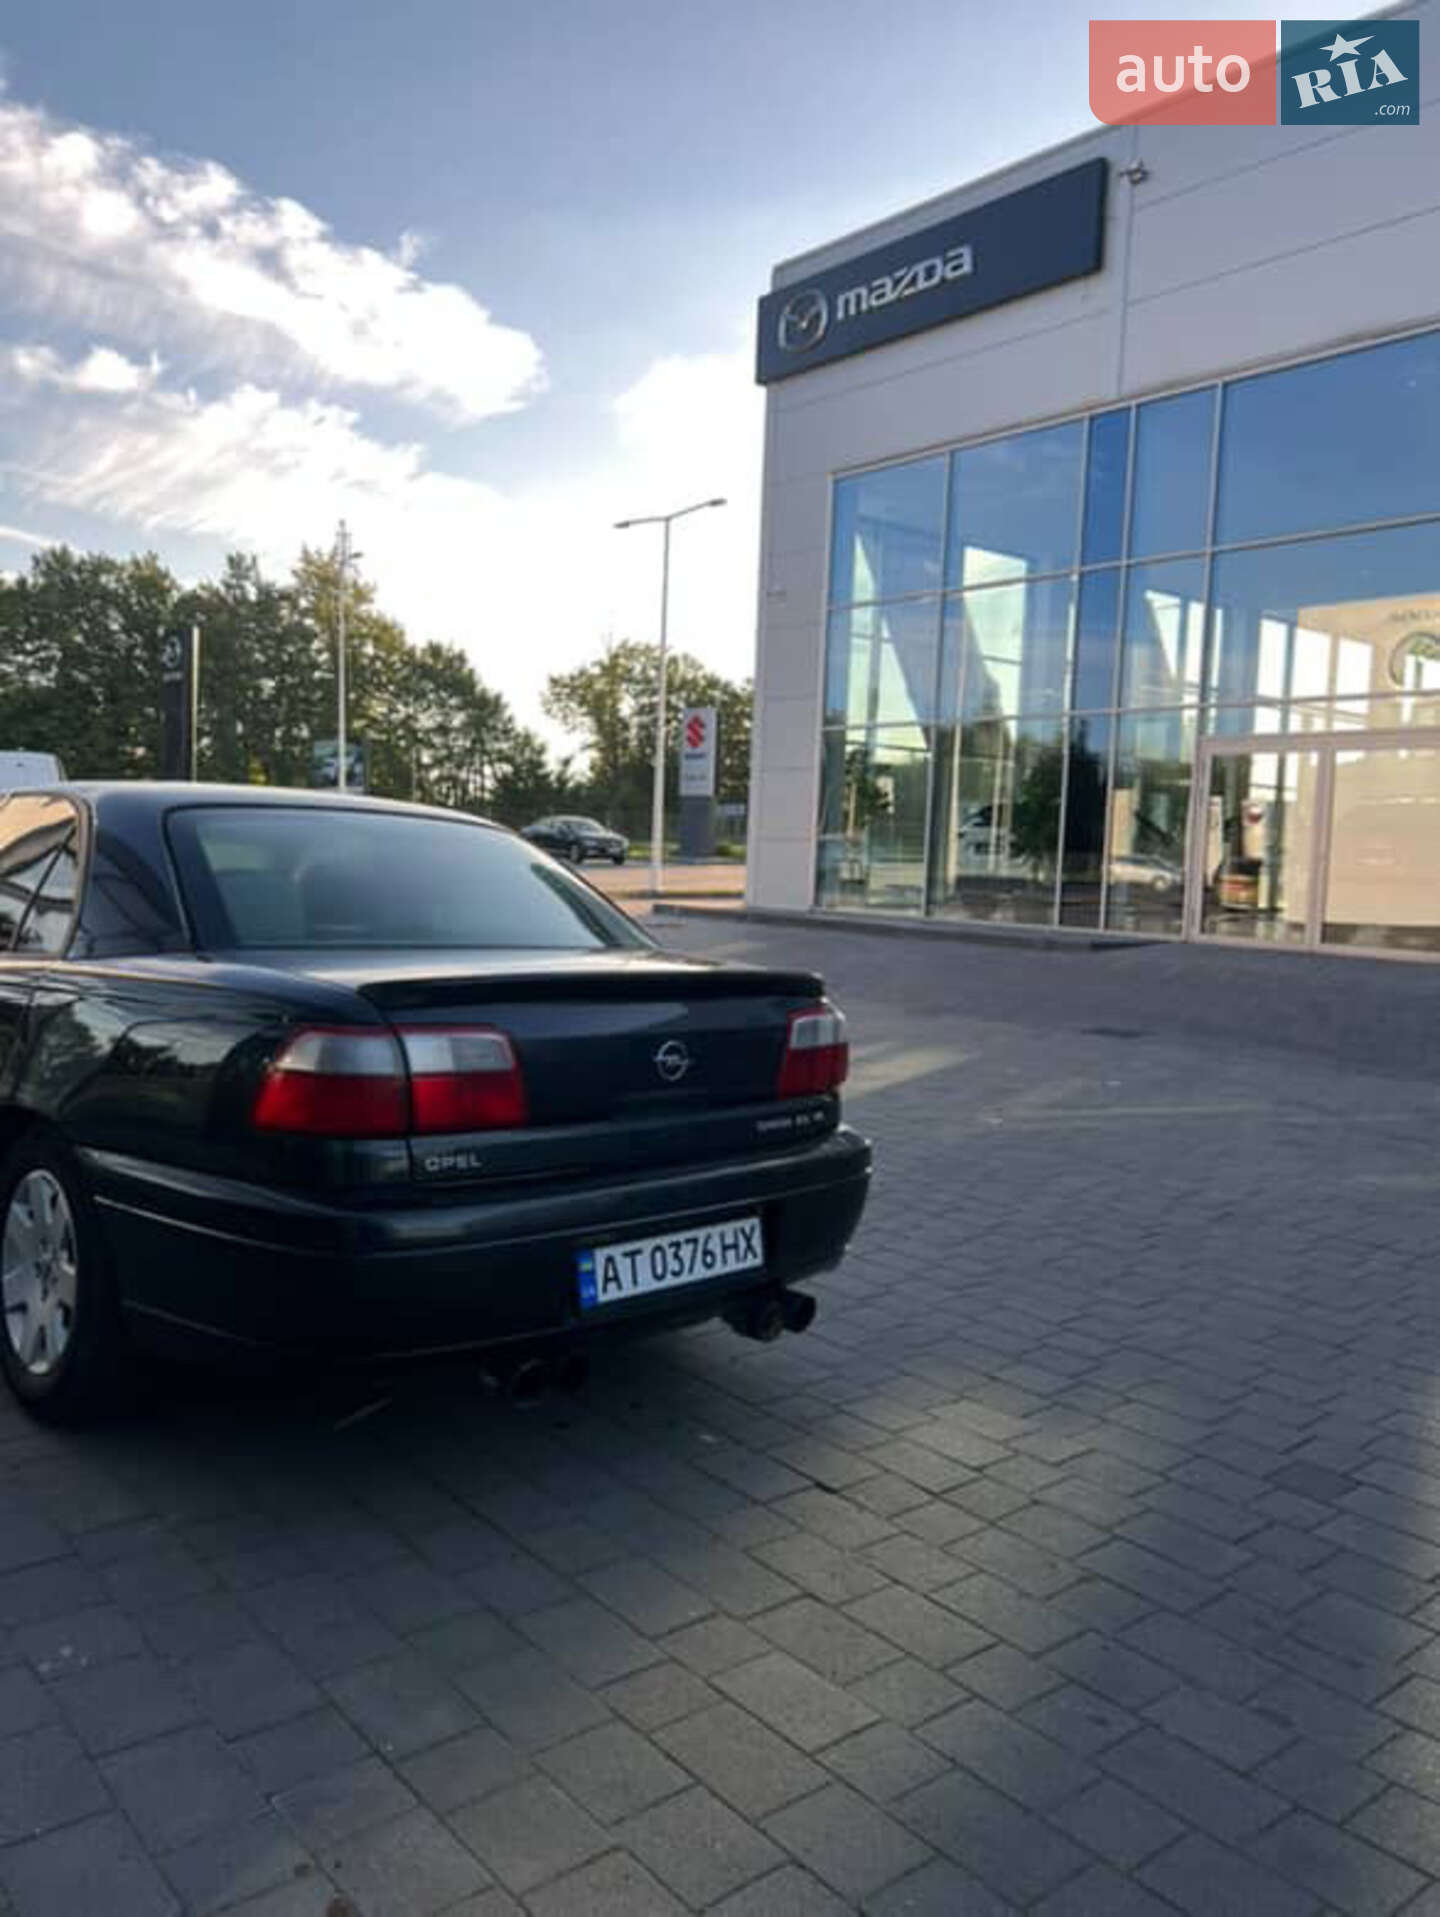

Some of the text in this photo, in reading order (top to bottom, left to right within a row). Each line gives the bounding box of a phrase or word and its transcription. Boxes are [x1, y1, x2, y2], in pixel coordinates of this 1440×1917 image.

[602, 1223, 759, 1294] AT 0376 HX
